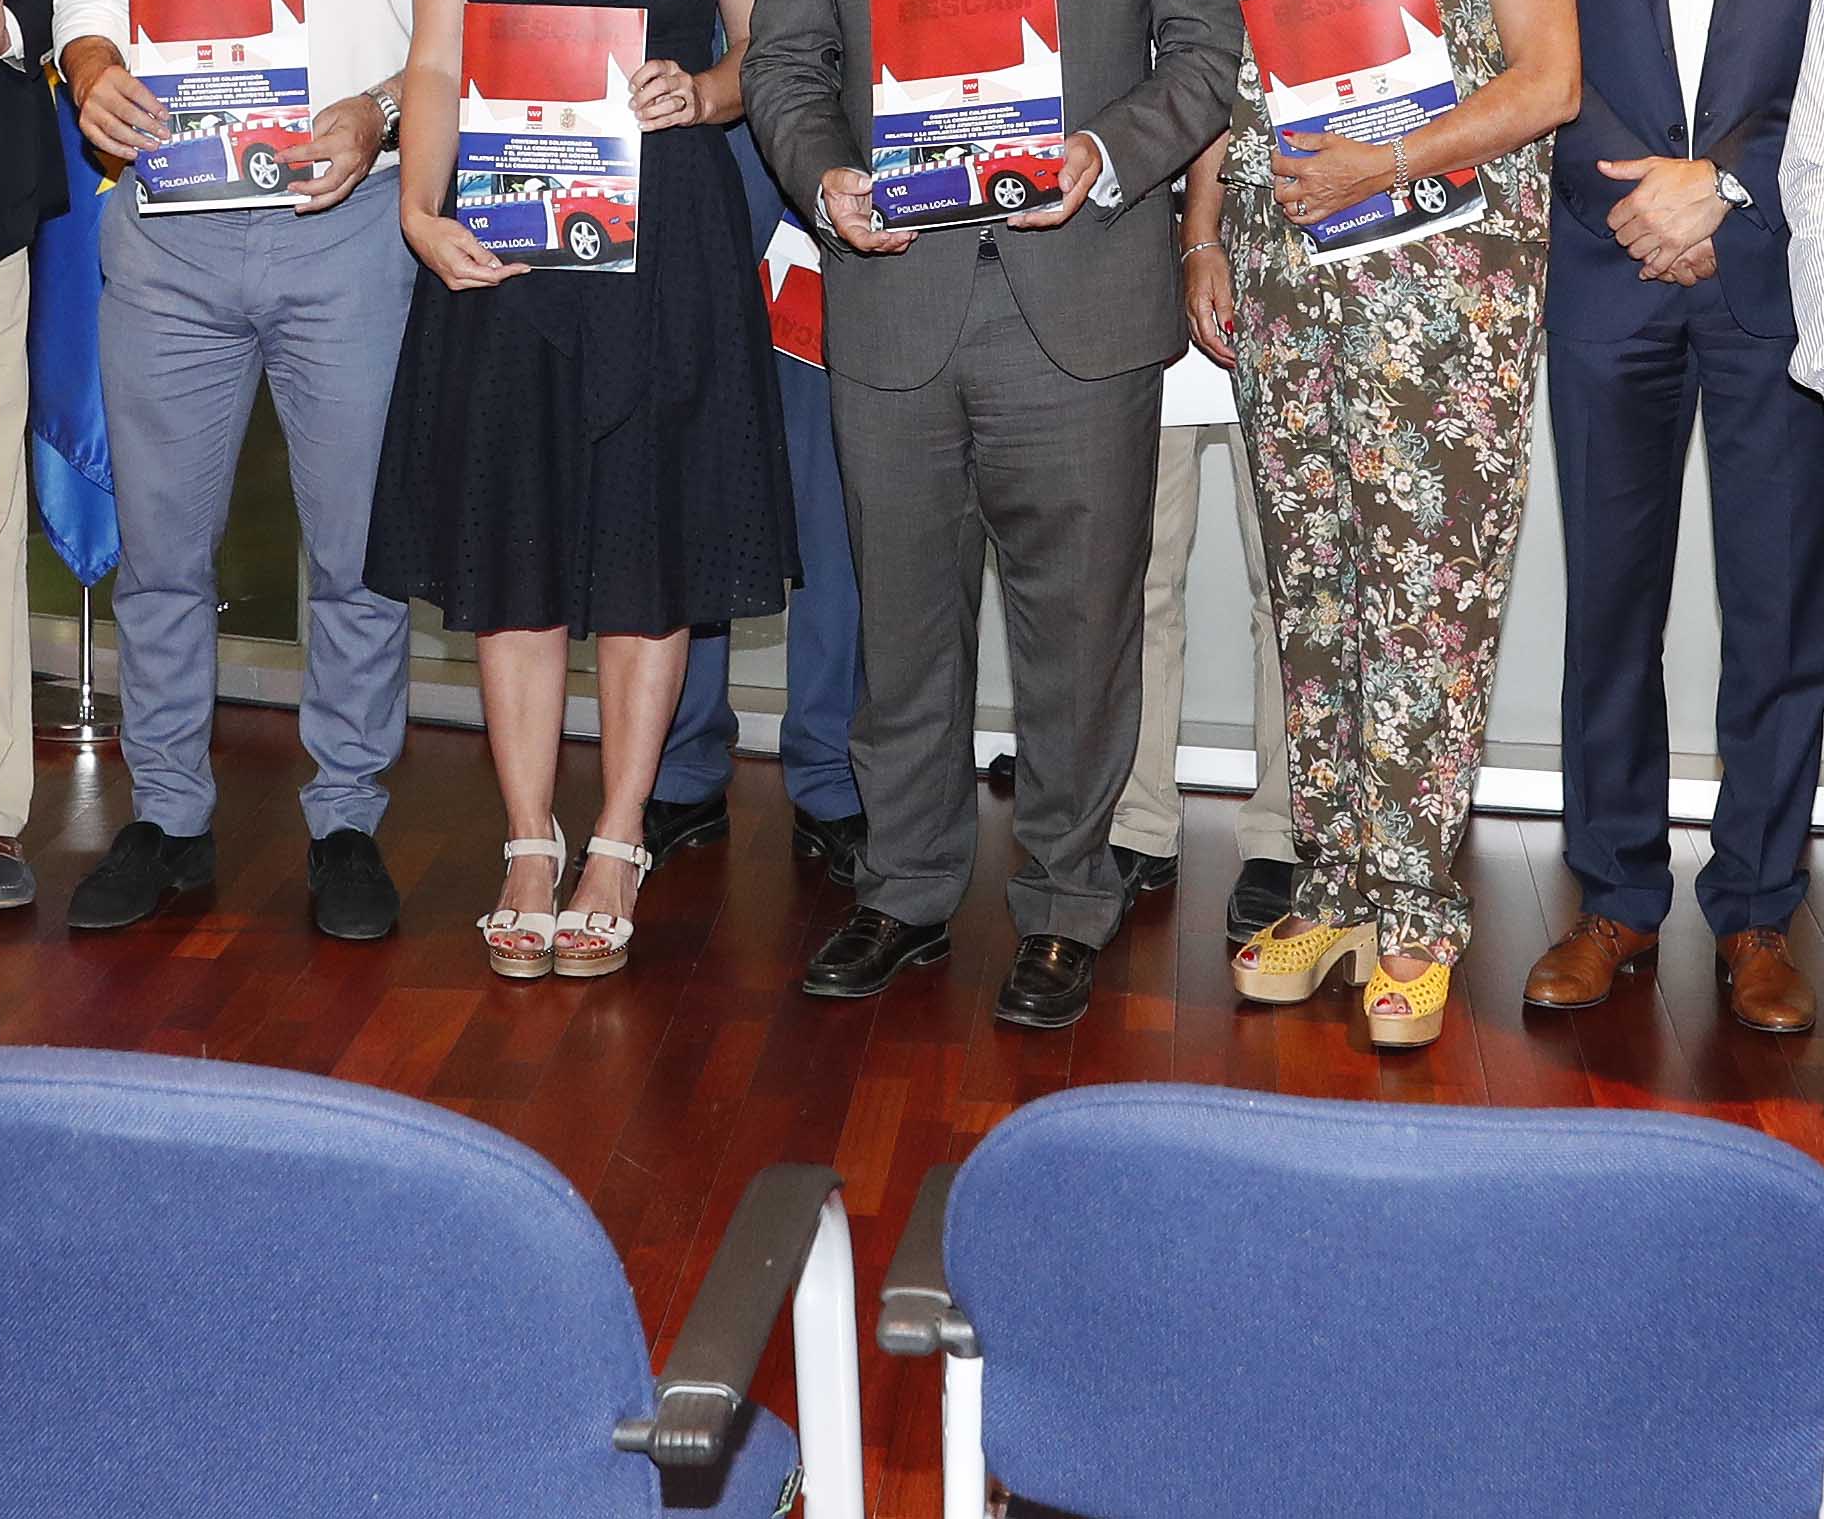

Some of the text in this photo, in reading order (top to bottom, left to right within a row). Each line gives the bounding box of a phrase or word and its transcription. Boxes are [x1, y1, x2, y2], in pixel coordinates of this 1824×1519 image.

[159, 173, 217, 189] POLICIA LOCAL
[894, 185, 908, 197] 112
[897, 198, 959, 215] POLICIA LOCAL
[1325, 209, 1384, 236] POLICIA LOCAL
[509, 238, 537, 248] LOCAL
